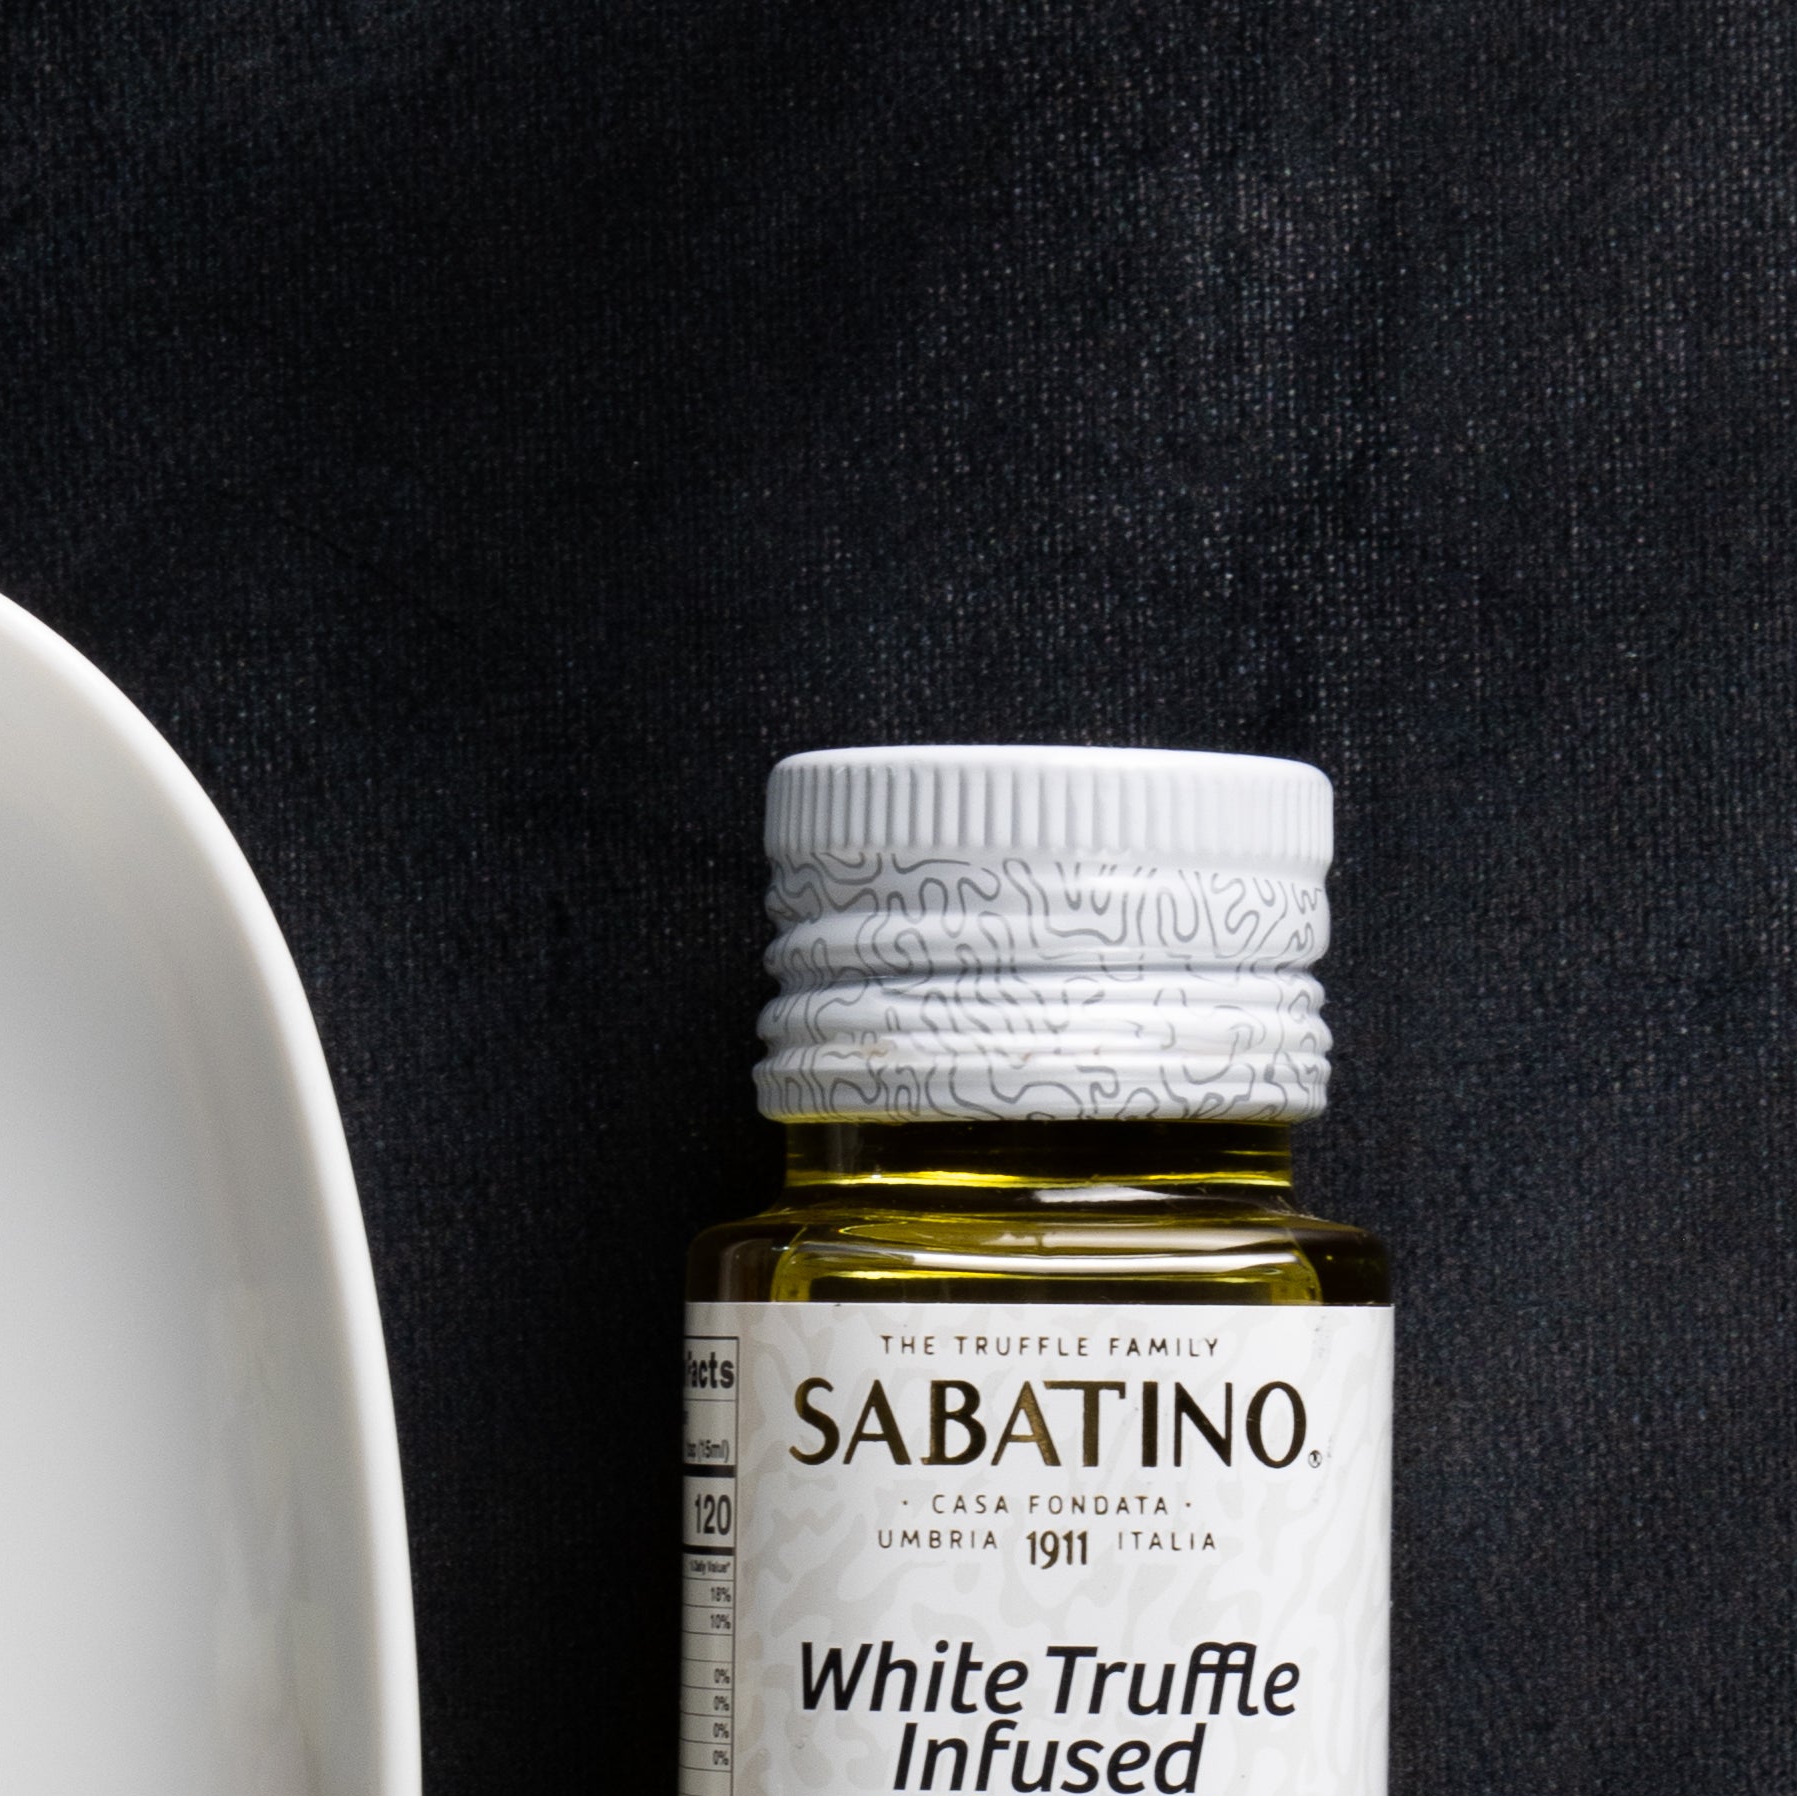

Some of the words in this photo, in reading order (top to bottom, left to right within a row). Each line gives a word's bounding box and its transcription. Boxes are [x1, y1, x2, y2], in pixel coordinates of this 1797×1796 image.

[880, 1335, 934, 1355] THE
[954, 1336, 1088, 1356] TRUFFLE
[1110, 1338, 1217, 1357] FAMILY
[695, 1494, 731, 1535] 120
[932, 1495, 1008, 1514] CASA
[1029, 1495, 1167, 1515] FONDATA
[878, 1530, 997, 1549] UMBRIA
[1026, 1530, 1087, 1569] 1911
[1119, 1531, 1215, 1551] ITALIA
[715, 1668, 730, 1683] 0%
[801, 1640, 1028, 1714] White
[1046, 1642, 1300, 1716] Truffle
[714, 1696, 729, 1711] 0%
[713, 1722, 729, 1738] 0%
[713, 1750, 729, 1765] 0%
[893, 1719, 1207, 1794] Infused
